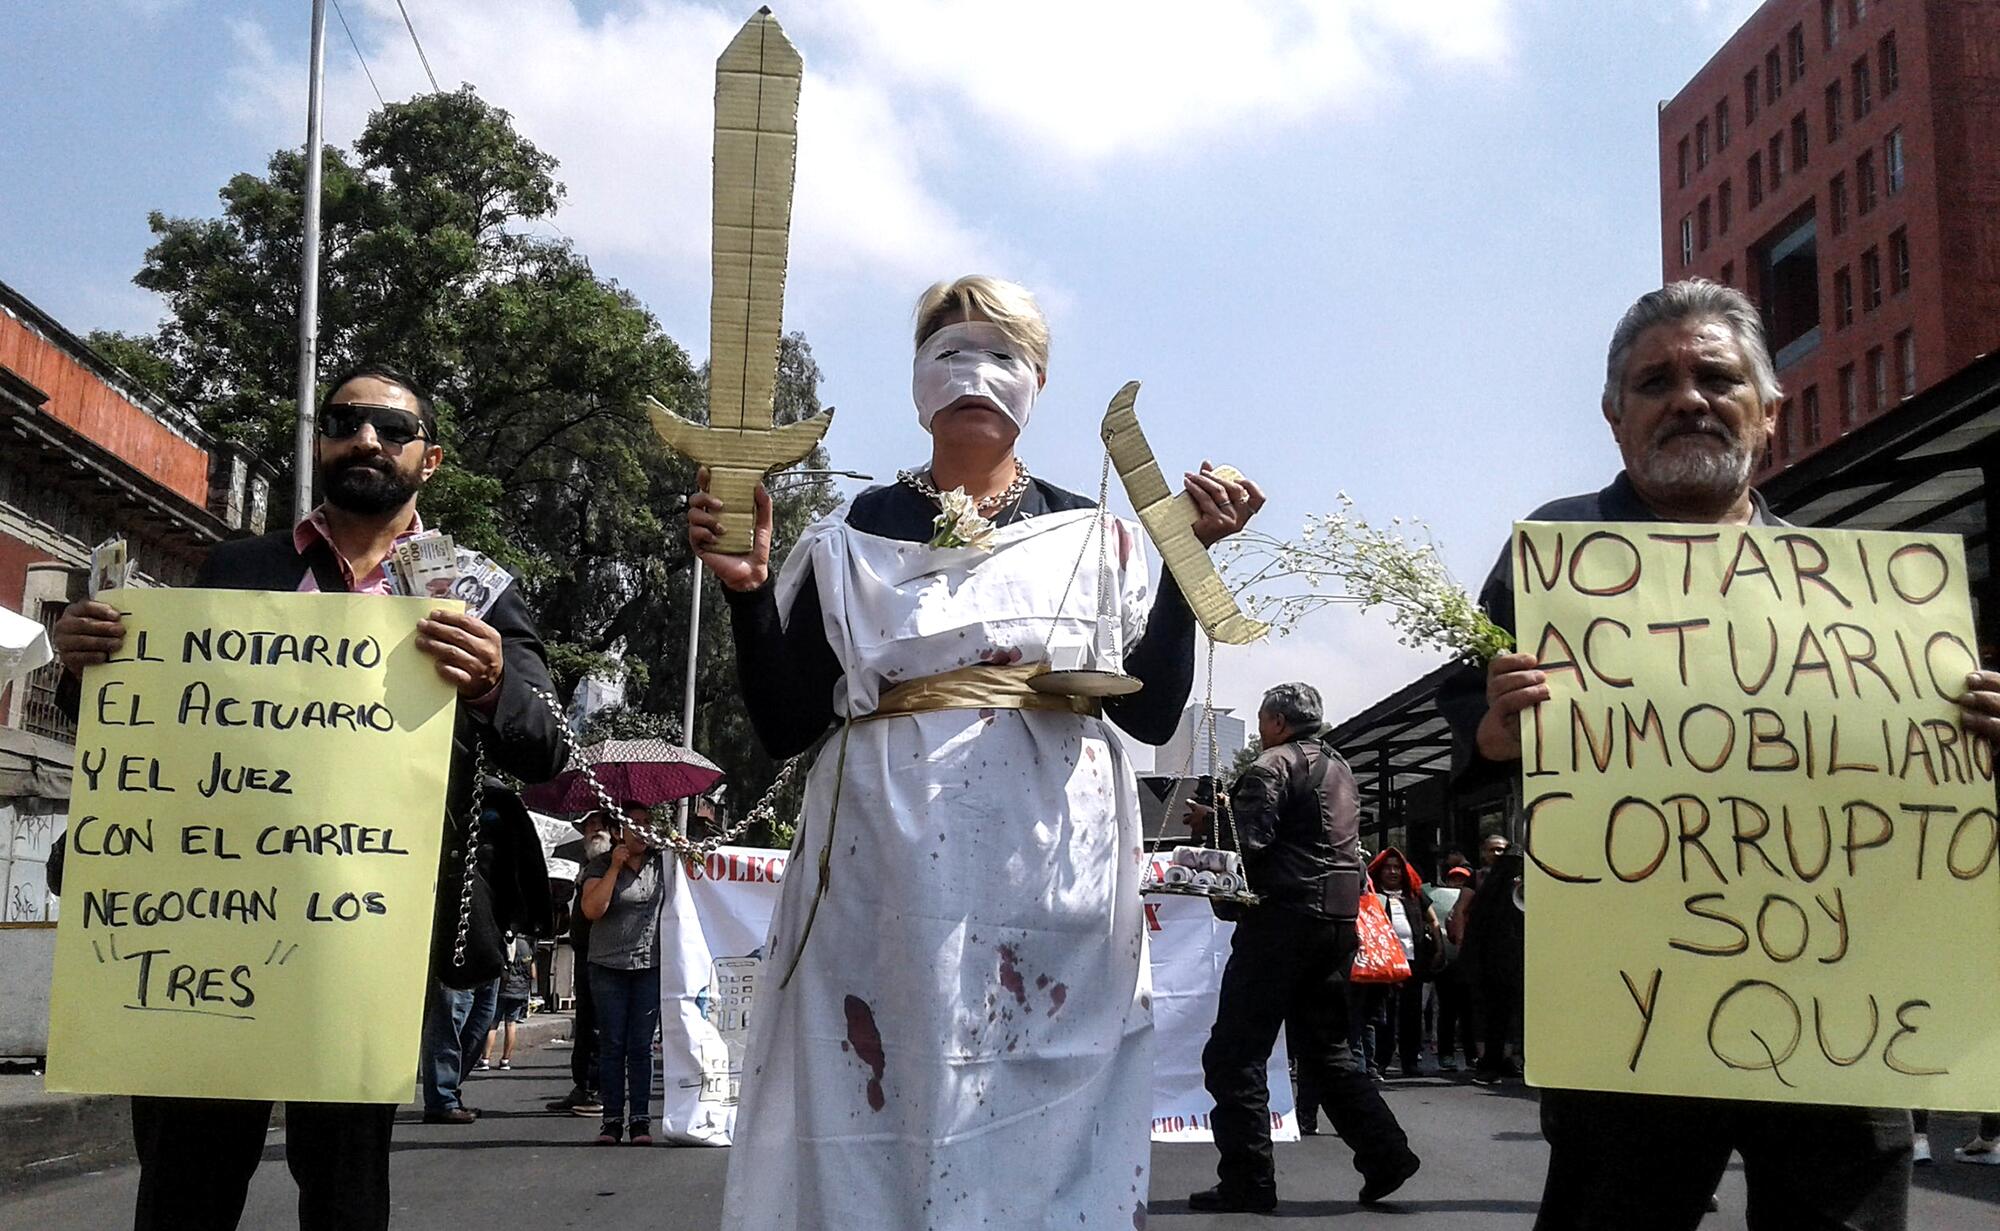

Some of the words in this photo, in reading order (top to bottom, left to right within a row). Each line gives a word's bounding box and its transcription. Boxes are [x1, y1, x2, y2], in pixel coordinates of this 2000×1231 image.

[1518, 530, 1949, 608] NOTARIO
[182, 627, 382, 669] NOTARIO
[1534, 615, 1977, 704] ACTUARIO
[98, 681, 155, 726] EL
[178, 681, 394, 733] ACTUARIO
[1525, 700, 1993, 786] INMOBILIARIO
[82, 747, 107, 792] Y
[118, 755, 175, 792] EL
[198, 752, 293, 798] JUEZ
[74, 816, 154, 856] CON
[181, 826, 241, 859] EL
[256, 823, 409, 857] CARTEL
[1524, 792, 1998, 884] CORRUPTO
[84, 886, 277, 928] NEGOCIAN
[307, 891, 387, 923] LOS
[1668, 887, 1849, 964] SOY
[1620, 968, 1662, 1072] Y
[1706, 978, 1949, 1088] QUE
